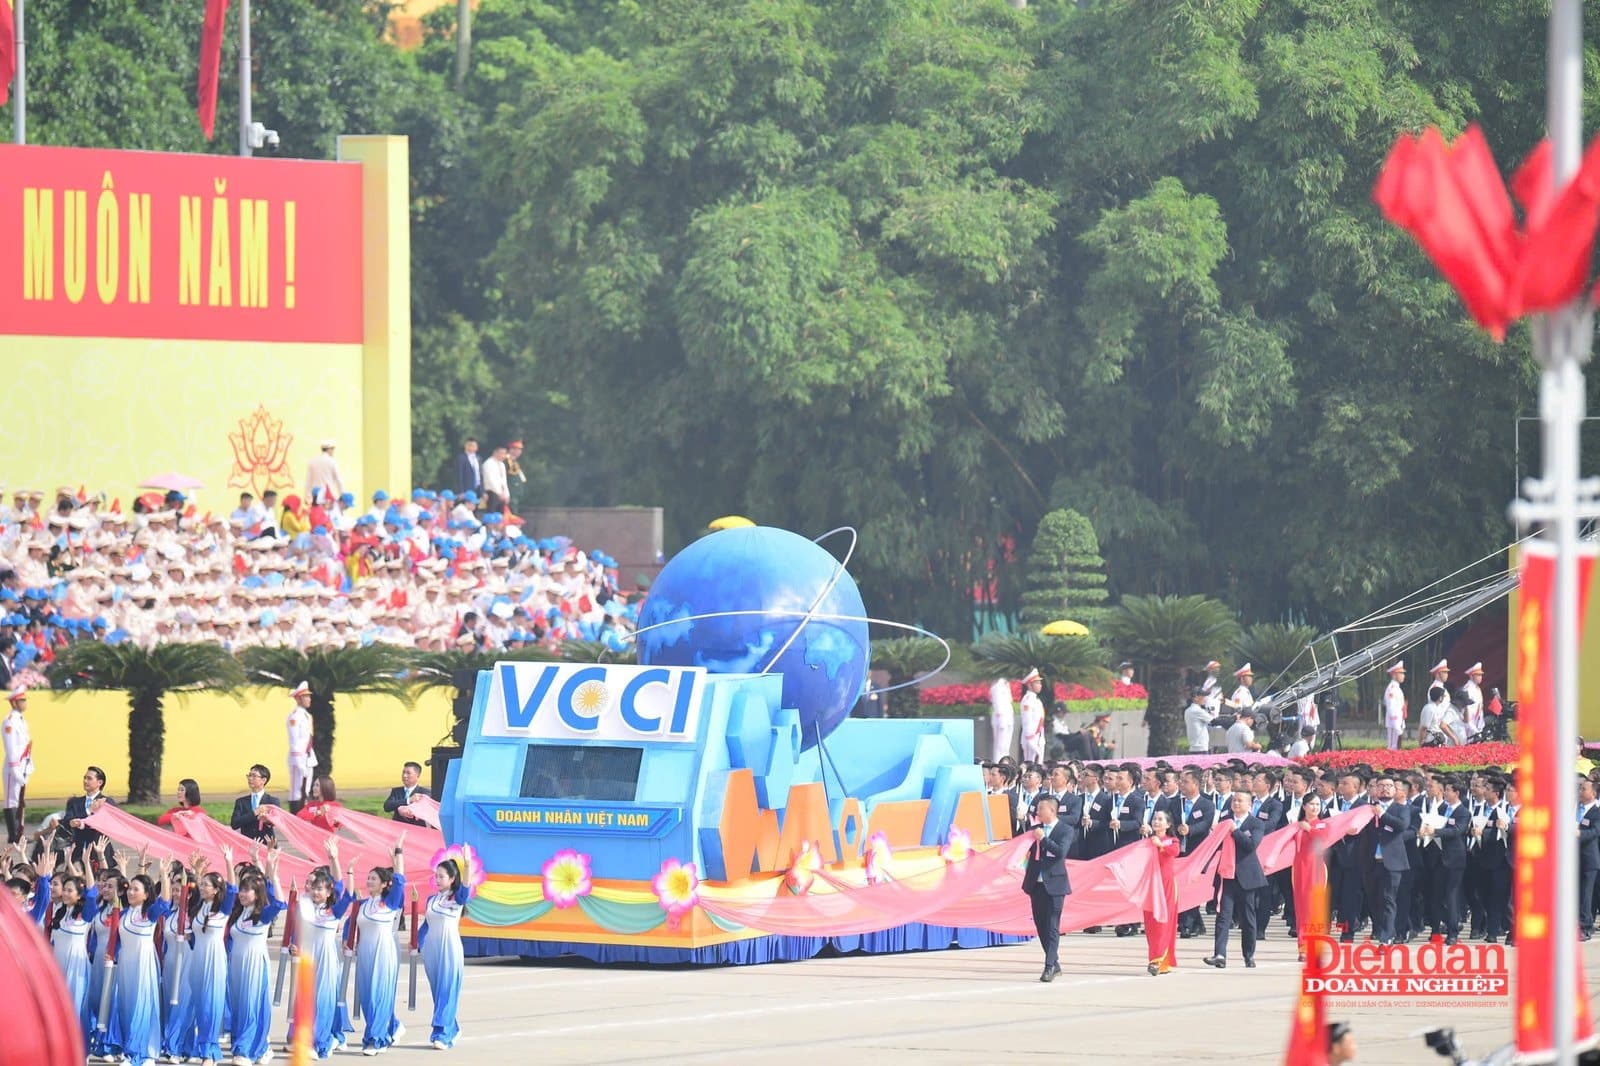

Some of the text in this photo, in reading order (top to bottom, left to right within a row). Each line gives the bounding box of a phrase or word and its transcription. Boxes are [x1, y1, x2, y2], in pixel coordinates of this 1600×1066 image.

[23, 170, 151, 304] MUÔN
[179, 177, 269, 308] NĂM
[500, 664, 697, 733] VCCI
[495, 808, 649, 828] DOANH NHÂN VIỆT NAM
